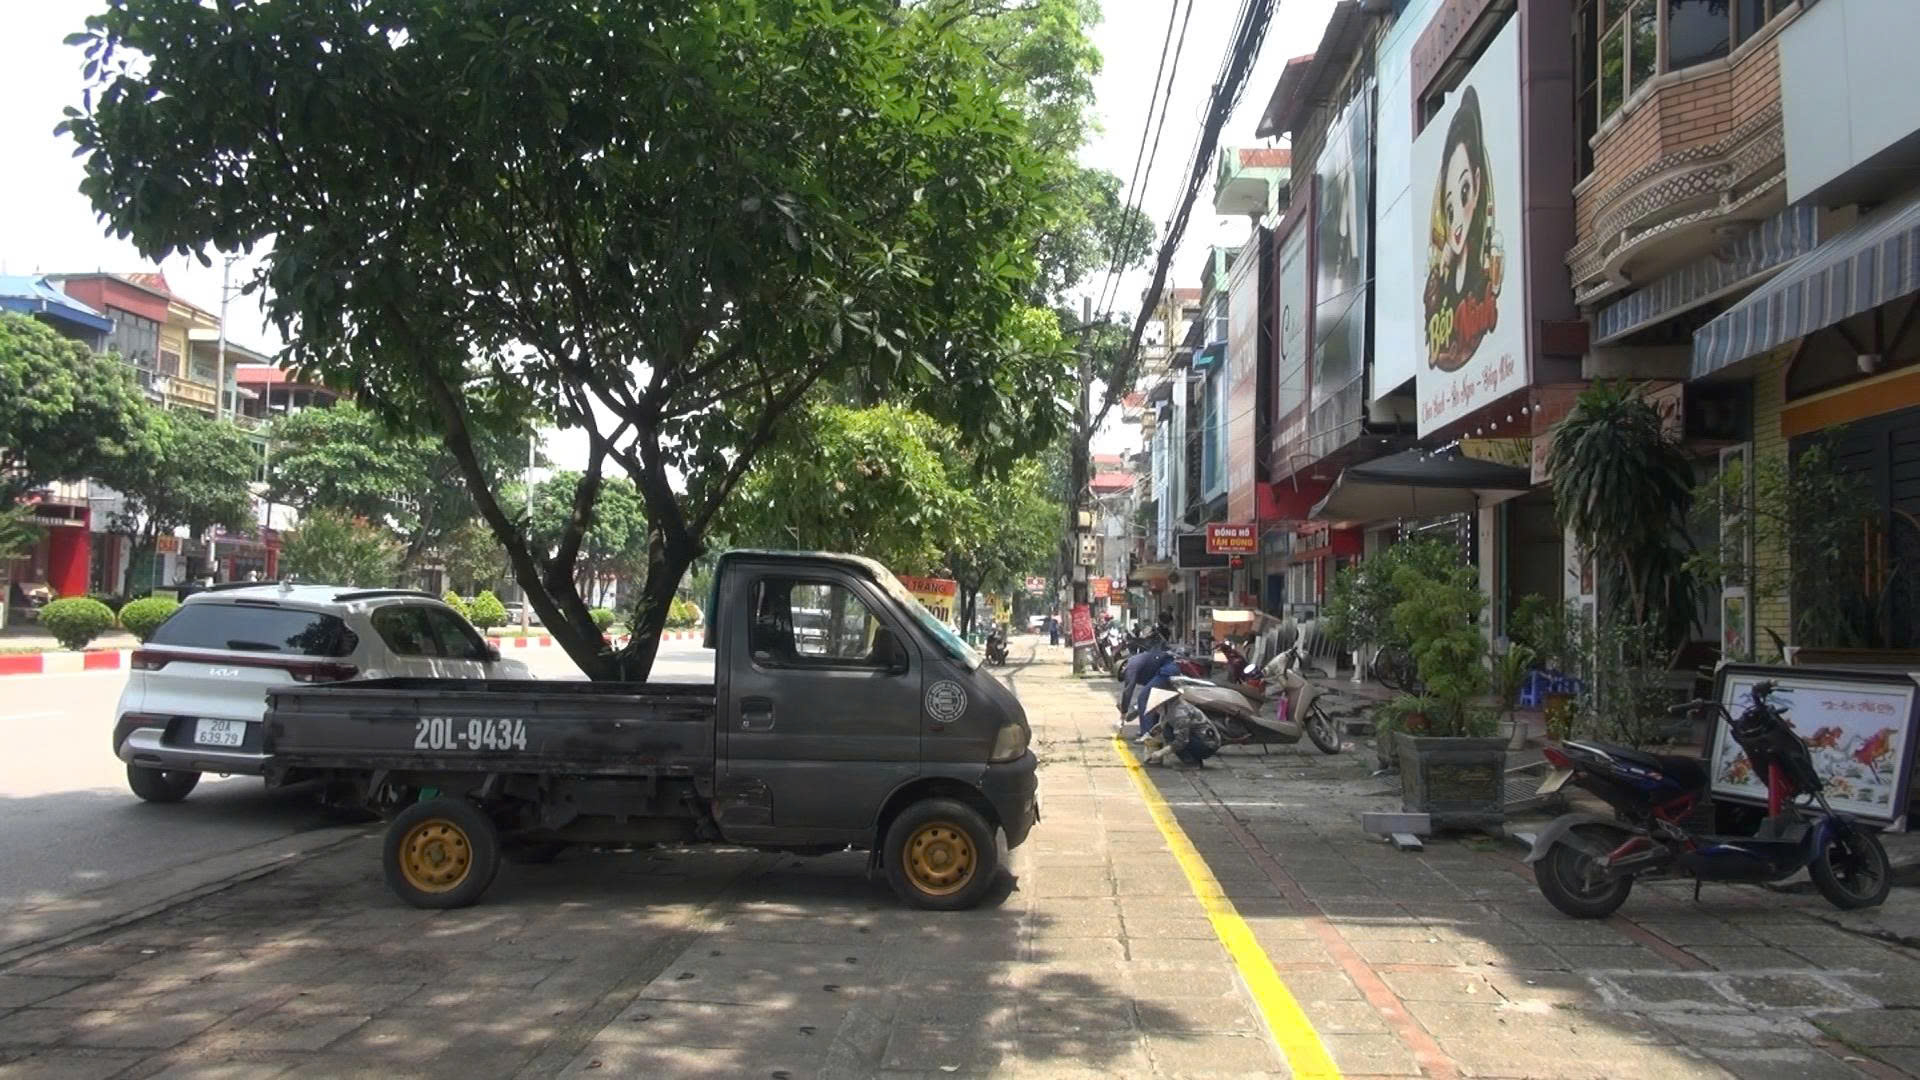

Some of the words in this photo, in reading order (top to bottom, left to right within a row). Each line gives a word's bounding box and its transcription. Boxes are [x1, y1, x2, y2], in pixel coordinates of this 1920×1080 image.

[209, 668, 239, 677] KIA
[211, 720, 231, 731] 20A
[200, 731, 239, 745] 639.79
[414, 718, 528, 751] 20L-9434
